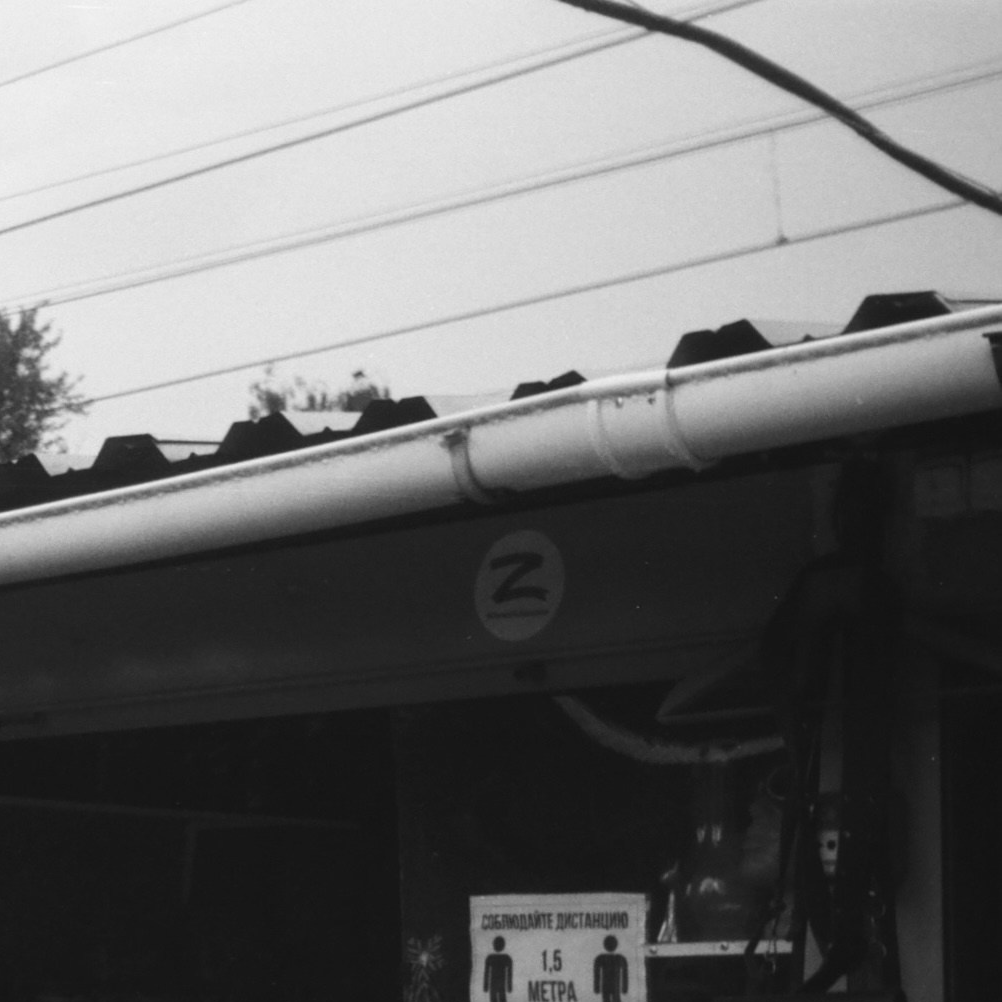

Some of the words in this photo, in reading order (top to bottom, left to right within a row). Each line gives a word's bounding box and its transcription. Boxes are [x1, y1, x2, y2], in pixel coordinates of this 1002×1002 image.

[481, 910, 553, 931] СОБЛЮДАЙТЕ
[555, 911, 629, 931] ДИСТАНЦИЮ
[541, 949, 563, 973] 1,5
[527, 980, 578, 1002] МЕТРА
